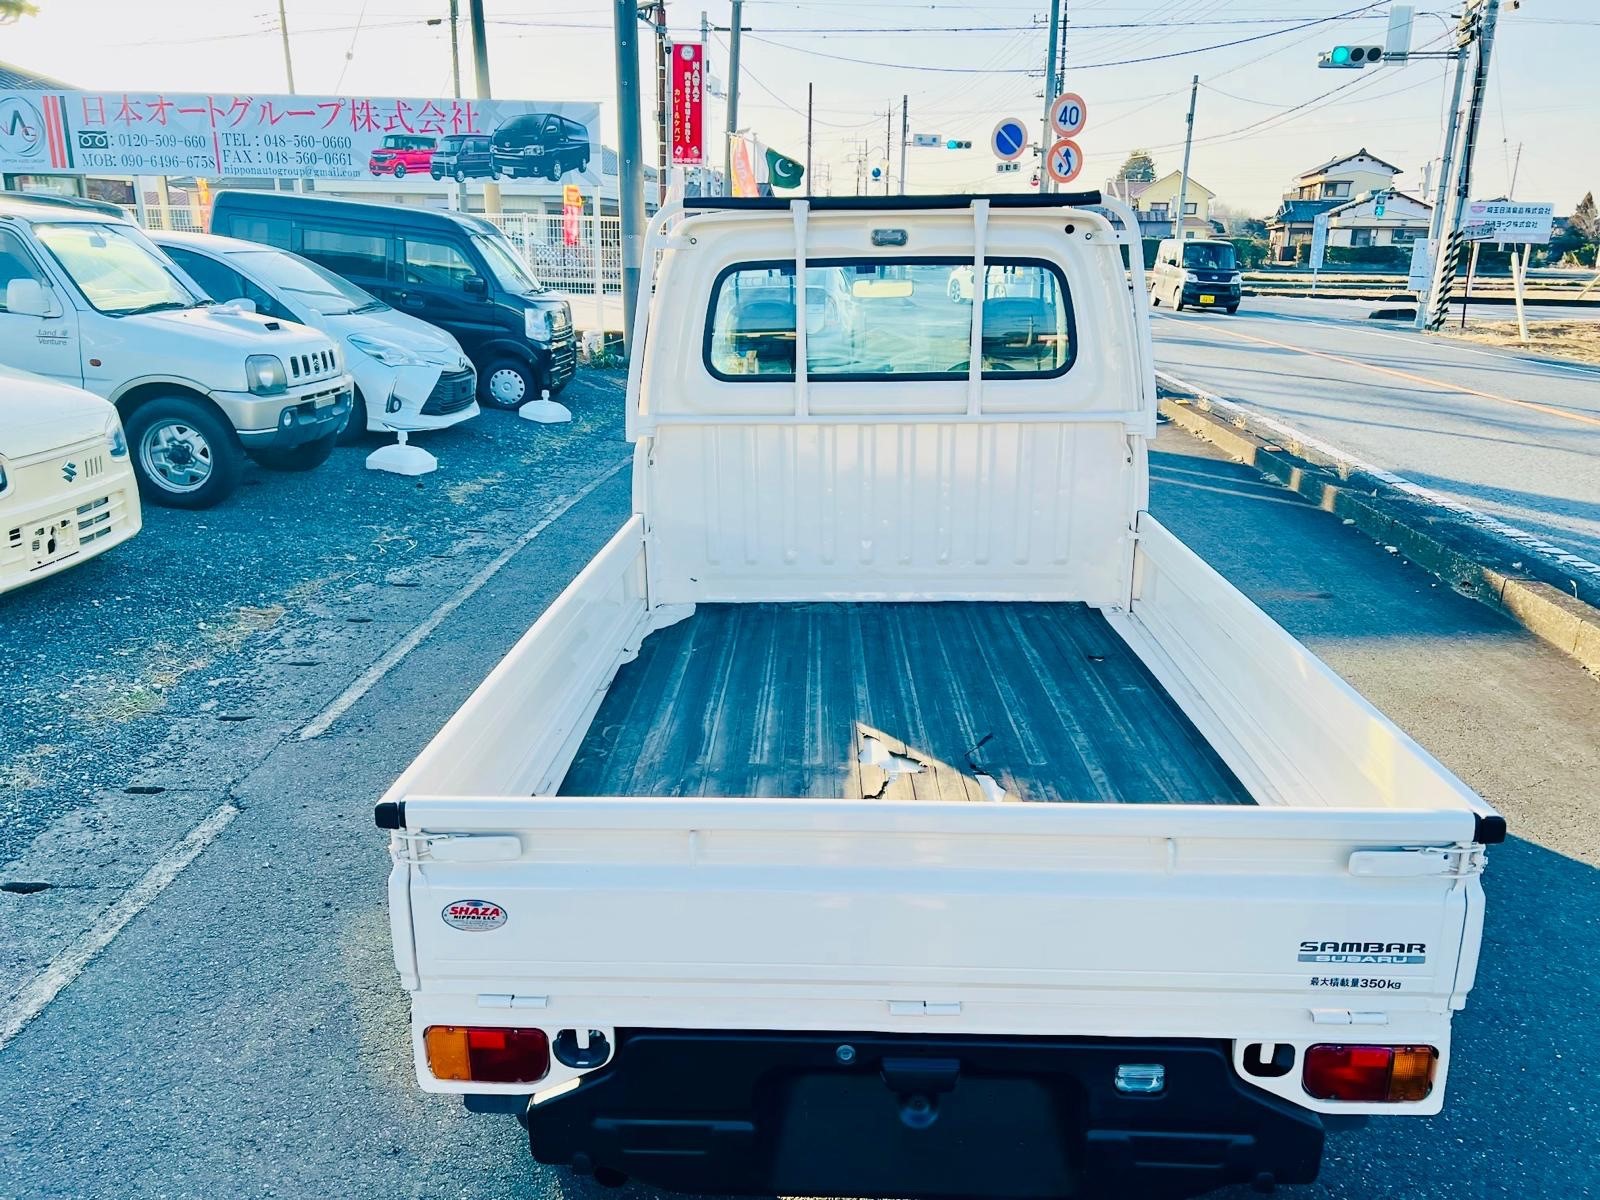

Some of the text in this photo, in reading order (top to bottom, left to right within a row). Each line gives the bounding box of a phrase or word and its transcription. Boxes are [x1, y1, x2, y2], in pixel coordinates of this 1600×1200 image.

[82, 94, 481, 135] 日本オートグループ株式会社
[1058, 105, 1080, 126] 40
[118, 133, 206, 148] 0120-509-660
[263, 134, 352, 149] 048-560-0660
[121, 154, 216, 168] 090-6496-6758
[265, 151, 353, 166] 048-560-0661
[224, 166, 361, 178] nipponautogroup@gmail.com
[38, 329, 57, 337] Land
[38, 338, 68, 346] Venture
[449, 906, 501, 917] SHAZA
[1300, 941, 1426, 954] SAMBAR
[1315, 954, 1408, 964] SUBARU
